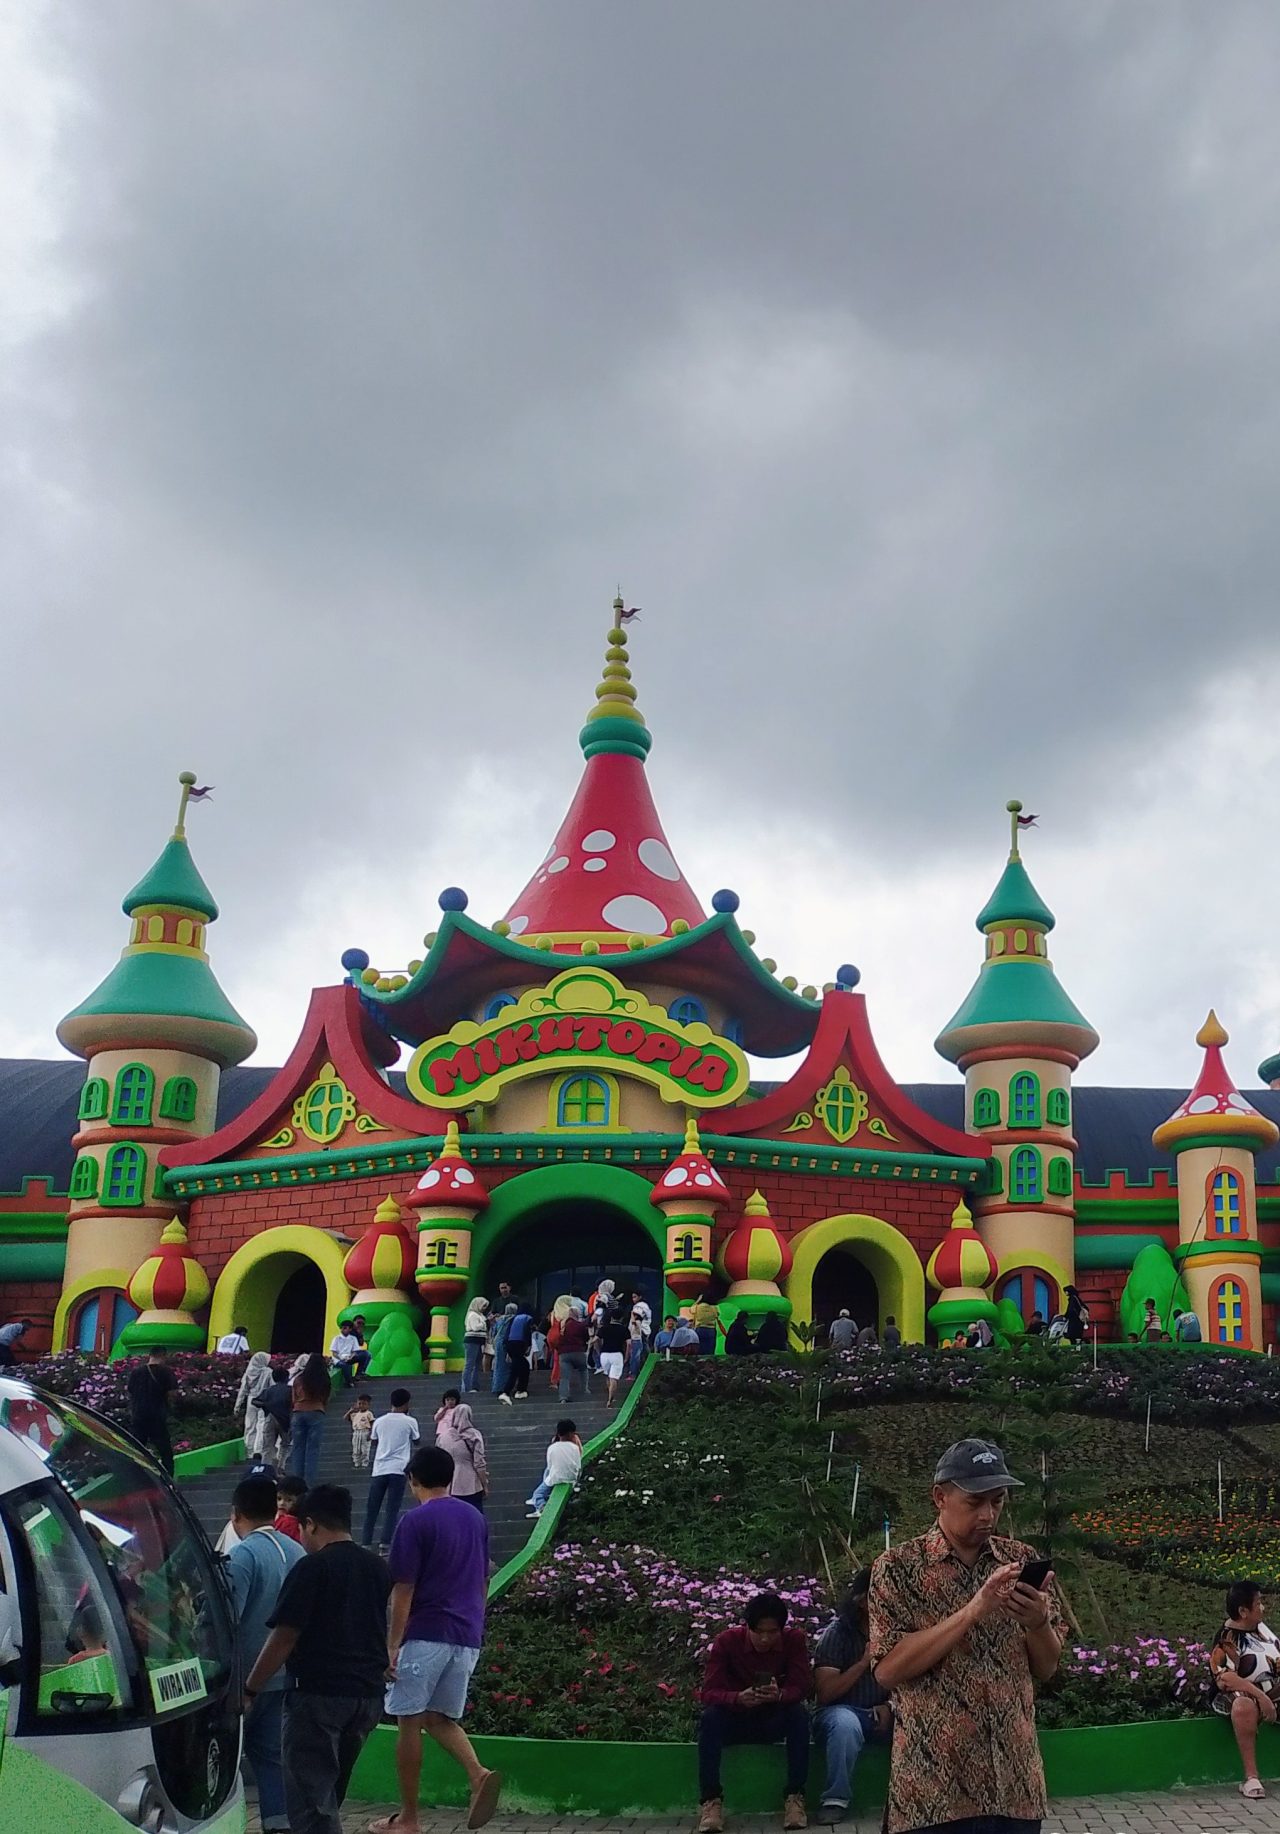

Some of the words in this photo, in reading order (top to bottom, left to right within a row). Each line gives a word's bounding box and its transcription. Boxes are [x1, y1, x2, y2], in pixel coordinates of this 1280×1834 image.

[429, 1016, 728, 1095] MIKUTOPIA
[157, 1672, 185, 1702] WIRA
[180, 1666, 202, 1695] WIRI
